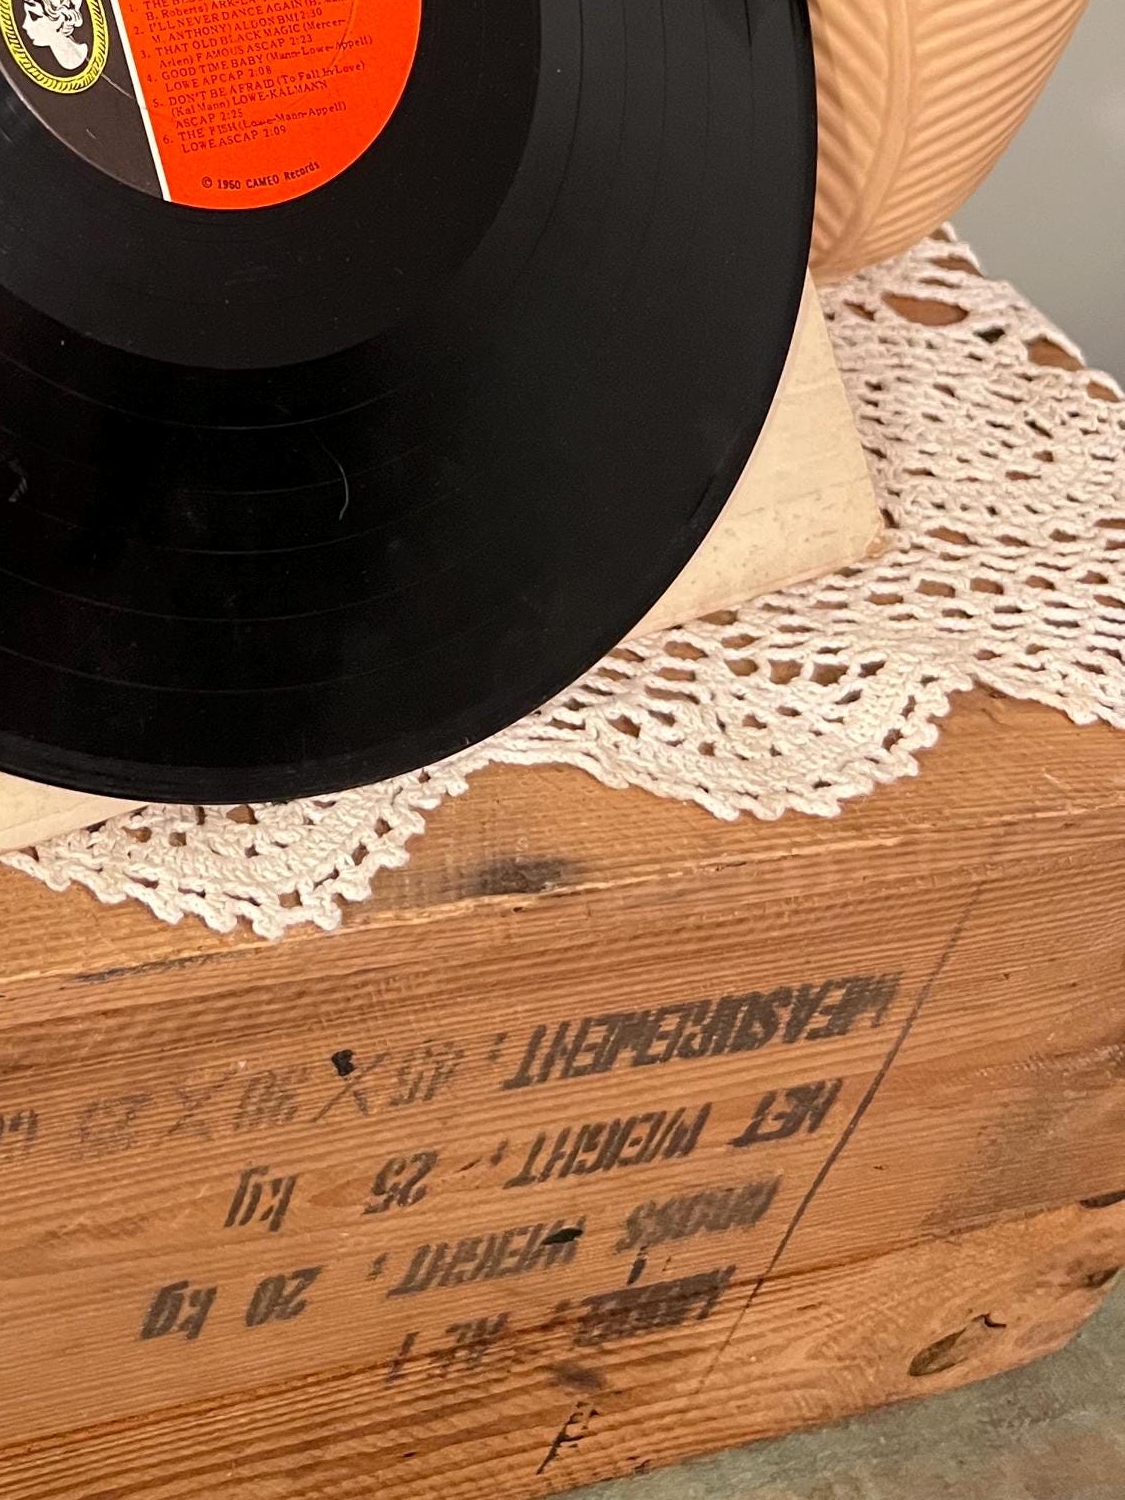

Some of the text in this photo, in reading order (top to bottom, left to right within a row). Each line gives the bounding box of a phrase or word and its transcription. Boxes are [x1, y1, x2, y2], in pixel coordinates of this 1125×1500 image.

[134, 26, 144, 35] 2.
[149, 21, 175, 33] I'LL
[178, 13, 219, 28] NEVER
[222, 5, 263, 21] DANCE
[266, 0, 302, 13] AGAIN
[146, 11, 158, 20] B.
[140, 50, 150, 59] 3.
[155, 42, 188, 56] THAT
[192, 37, 217, 50] OLD
[220, 30, 261, 45] BLACK
[264, 23, 301, 37] MAGIC
[169, 23, 232, 41] ANTHONY)
[247, 38, 284, 53] ASCAP
[162, 67, 195, 80] GOOD
[199, 61, 228, 74] TIME
[231, 53, 263, 68] BABY
[153, 99, 163, 108] 5.
[169, 91, 206, 106] DON'T
[210, 87, 226, 98] BE
[230, 79, 274, 95] AFRAID
[165, 79, 199, 93] LOWE
[176, 108, 243, 129] ASCAP 2:25
[163, 134, 173, 144] 6.
[178, 127, 204, 141] THE
[181, 139, 217, 154] LOWE
[219, 130, 259, 147] ASCAP
[246, 174, 280, 189] CAMEO
[284, 161, 320, 182] Records
[729, 1078, 844, 1148] NET
[361, 1150, 439, 1216] 25
[224, 1163, 299, 1234] kg
[140, 1280, 218, 1340] kg
[245, 1264, 323, 1328] 20
